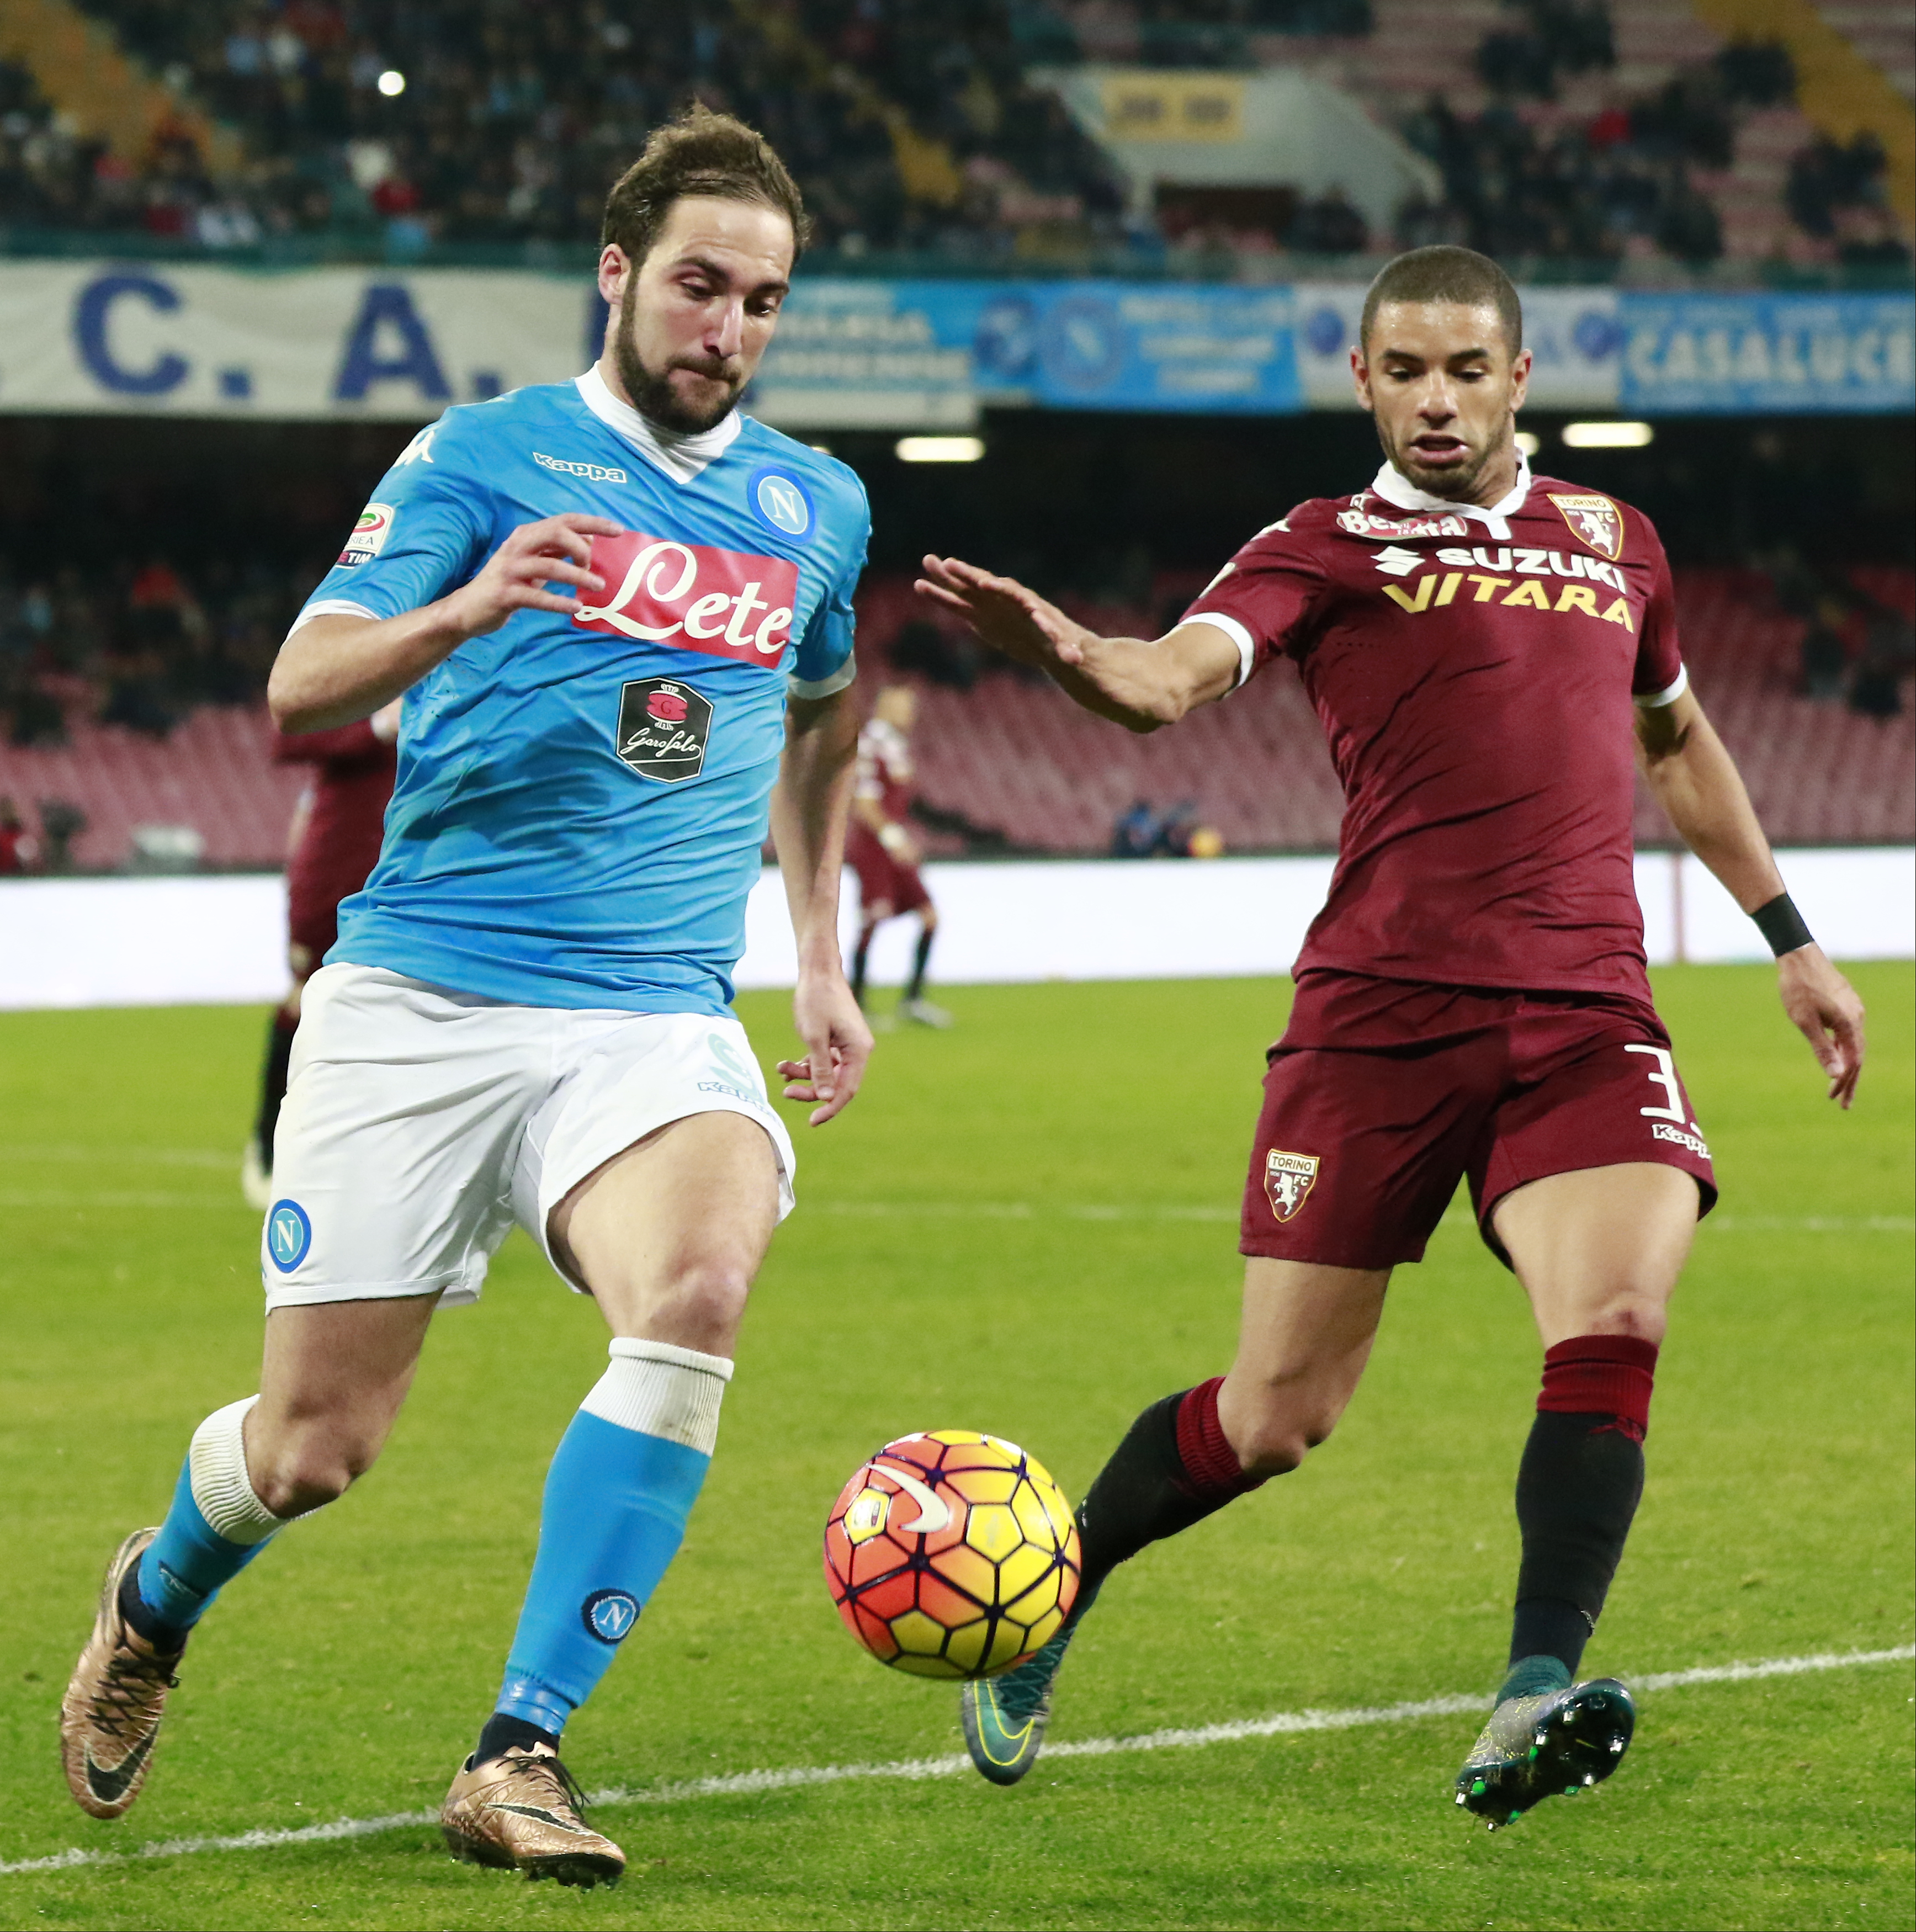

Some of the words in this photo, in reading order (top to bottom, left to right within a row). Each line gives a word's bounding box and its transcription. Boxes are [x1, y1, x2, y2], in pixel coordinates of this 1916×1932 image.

[533, 451, 628, 484] Kappa
[767, 486, 799, 525] N
[1558, 498, 1607, 508] TORINO
[347, 553, 372, 564] TIM
[1435, 546, 1627, 595] SUZUKI
[574, 541, 793, 655] Lete
[1381, 572, 1634, 634] VITARA
[620, 728, 702, 760] Garofalo
[1272, 1156, 1312, 1171] TORINO
[1293, 1175, 1309, 1187] FC
[276, 1220, 295, 1252] N
[599, 1601, 629, 1631] N
